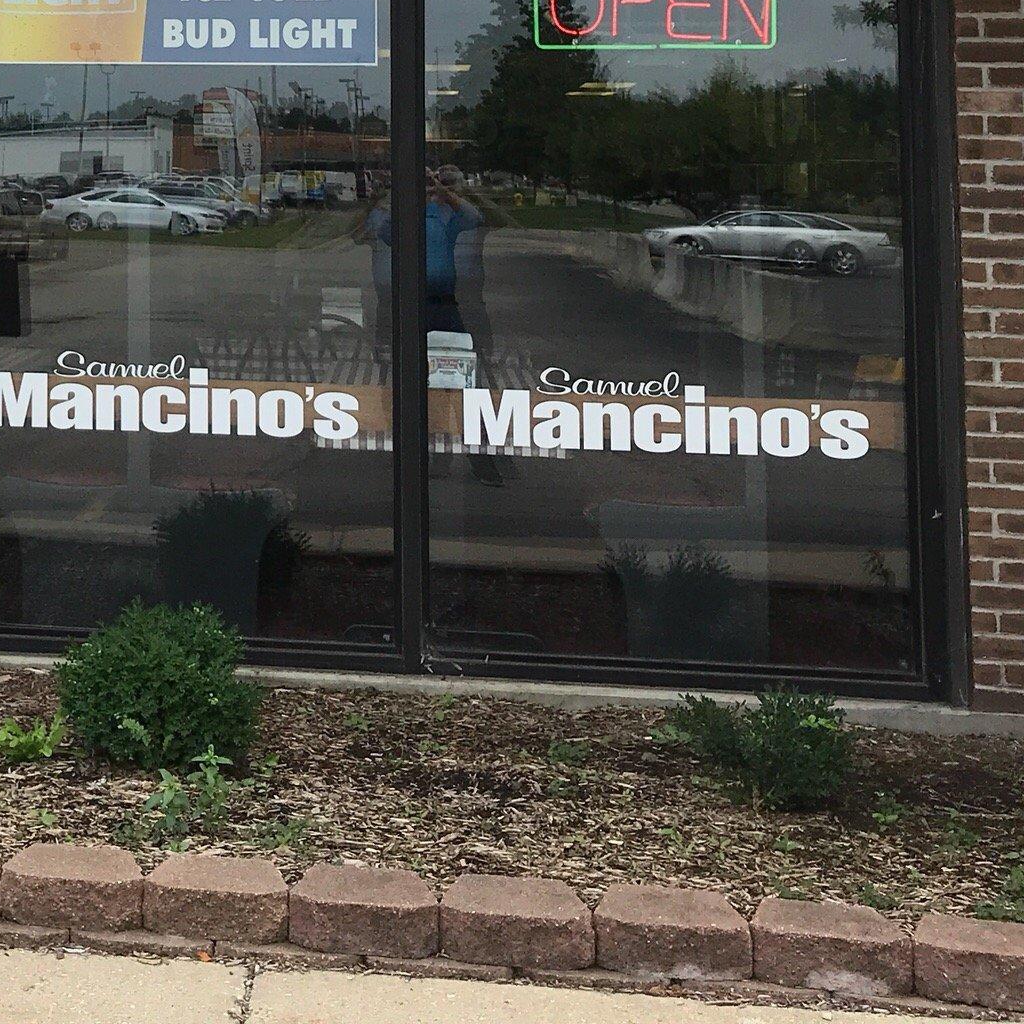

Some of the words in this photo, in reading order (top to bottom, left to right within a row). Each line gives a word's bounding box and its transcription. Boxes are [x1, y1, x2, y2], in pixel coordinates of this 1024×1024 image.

[162, 18, 237, 49] BUD
[249, 18, 358, 49] LIGHT
[53, 350, 185, 381] Samuel
[536, 366, 680, 398] Samuel
[462, 385, 870, 460] Mancino's
